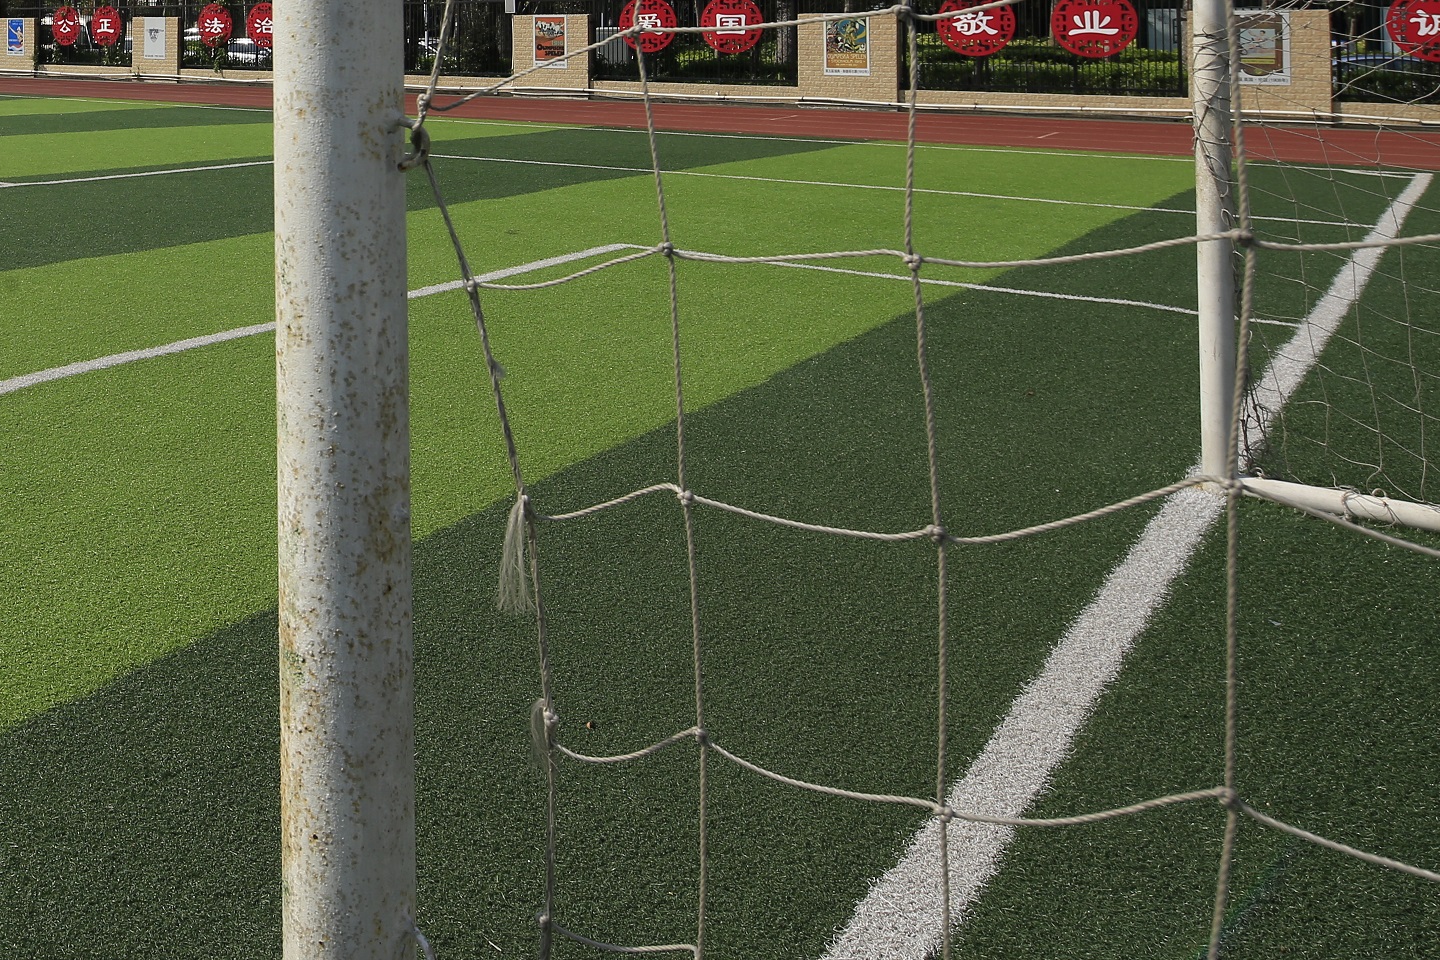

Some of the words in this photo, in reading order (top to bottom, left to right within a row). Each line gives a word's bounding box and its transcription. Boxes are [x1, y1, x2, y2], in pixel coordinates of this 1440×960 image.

[57, 19, 74, 33] 公
[97, 18, 115, 33] 正
[204, 17, 224, 33] 法
[254, 17, 273, 33] 治
[716, 13, 746, 35] 国
[952, 11, 998, 36] 敬
[1068, 10, 1119, 36] 业
